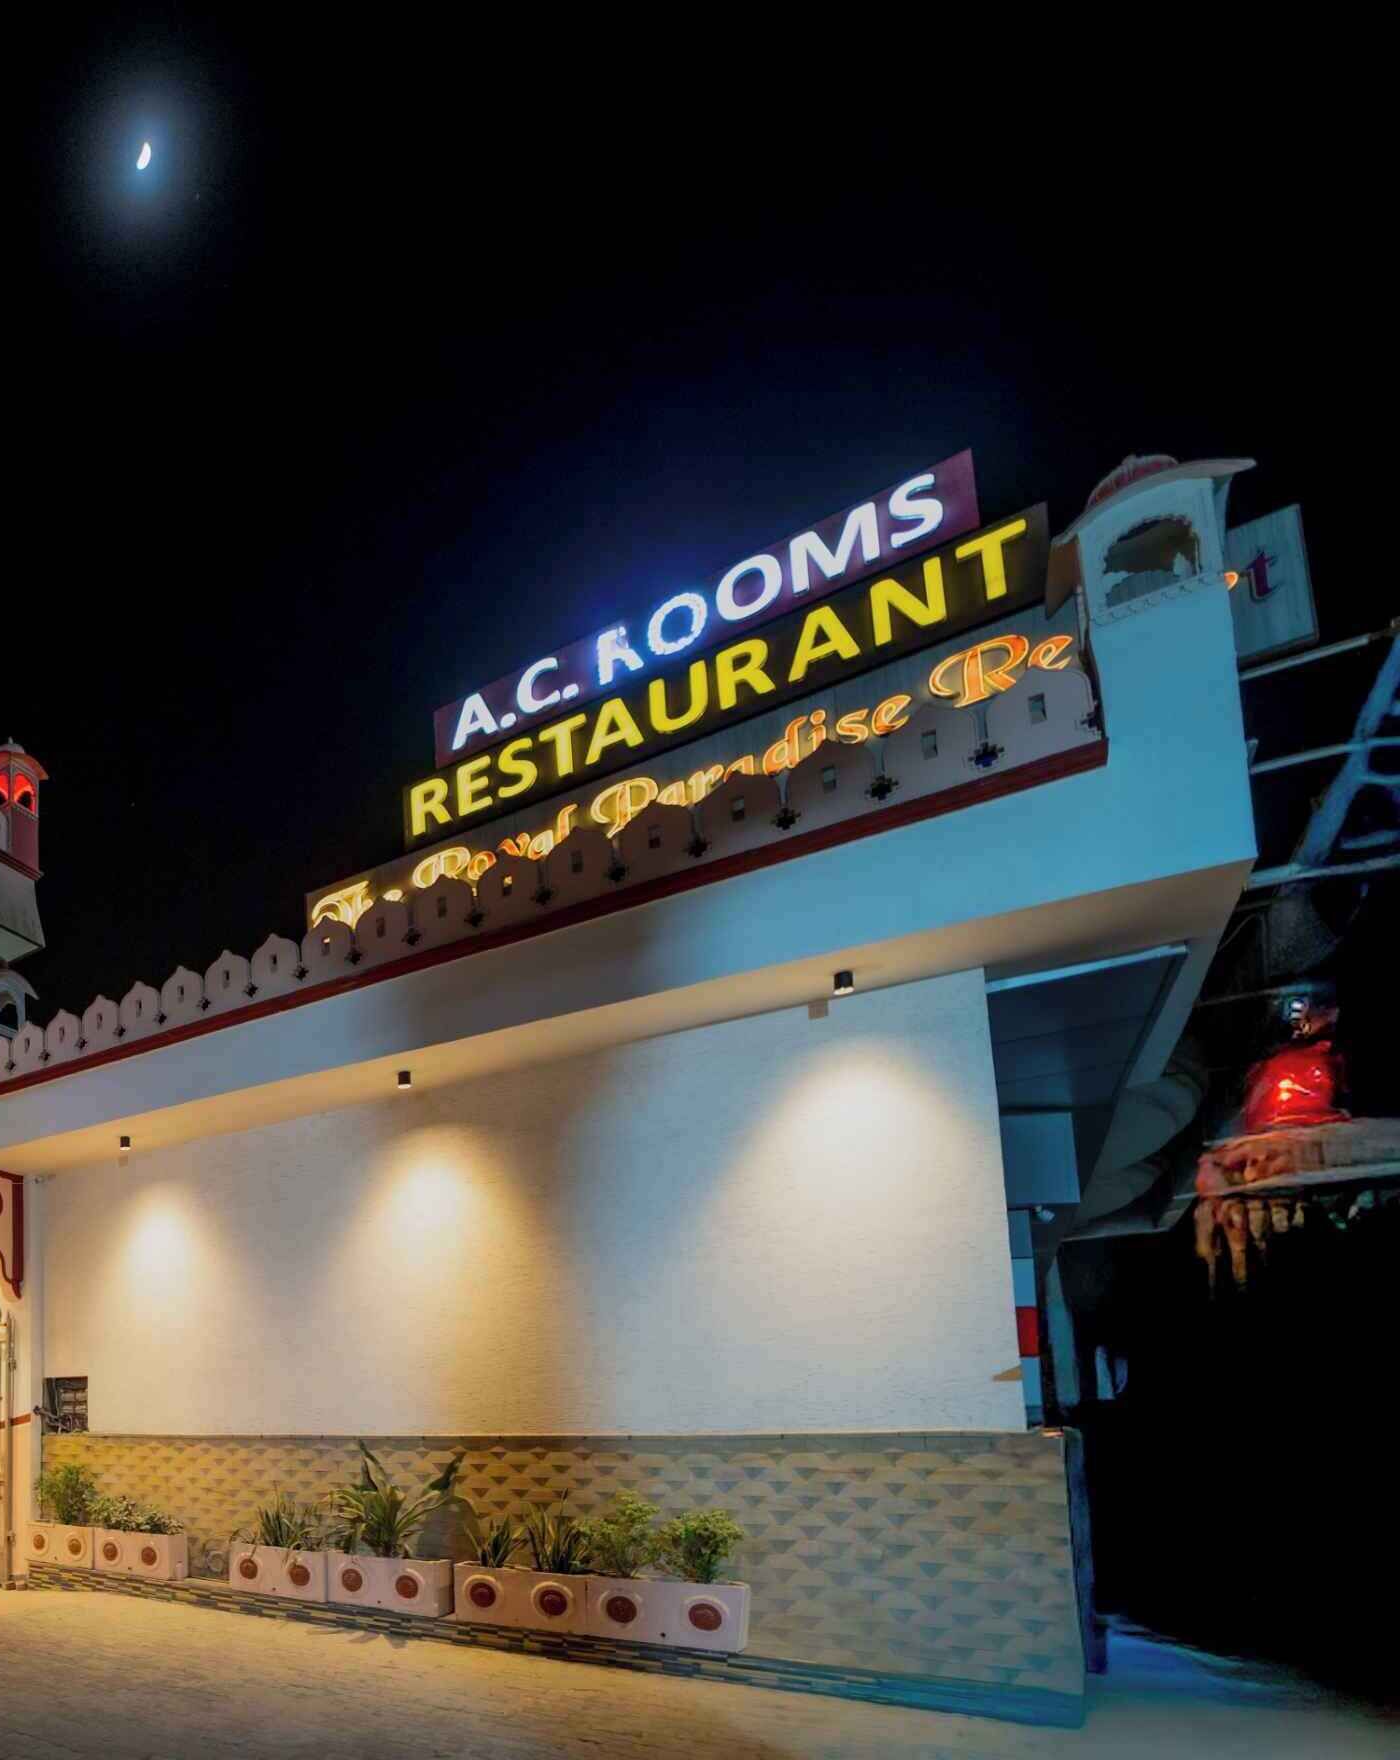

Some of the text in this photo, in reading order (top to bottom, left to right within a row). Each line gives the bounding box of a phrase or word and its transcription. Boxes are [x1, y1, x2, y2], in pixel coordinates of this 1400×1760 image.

[407, 518, 1028, 837] RESTAURANT
[451, 472, 945, 752] A.C. ROOMS
[589, 693, 913, 840] Paradise
